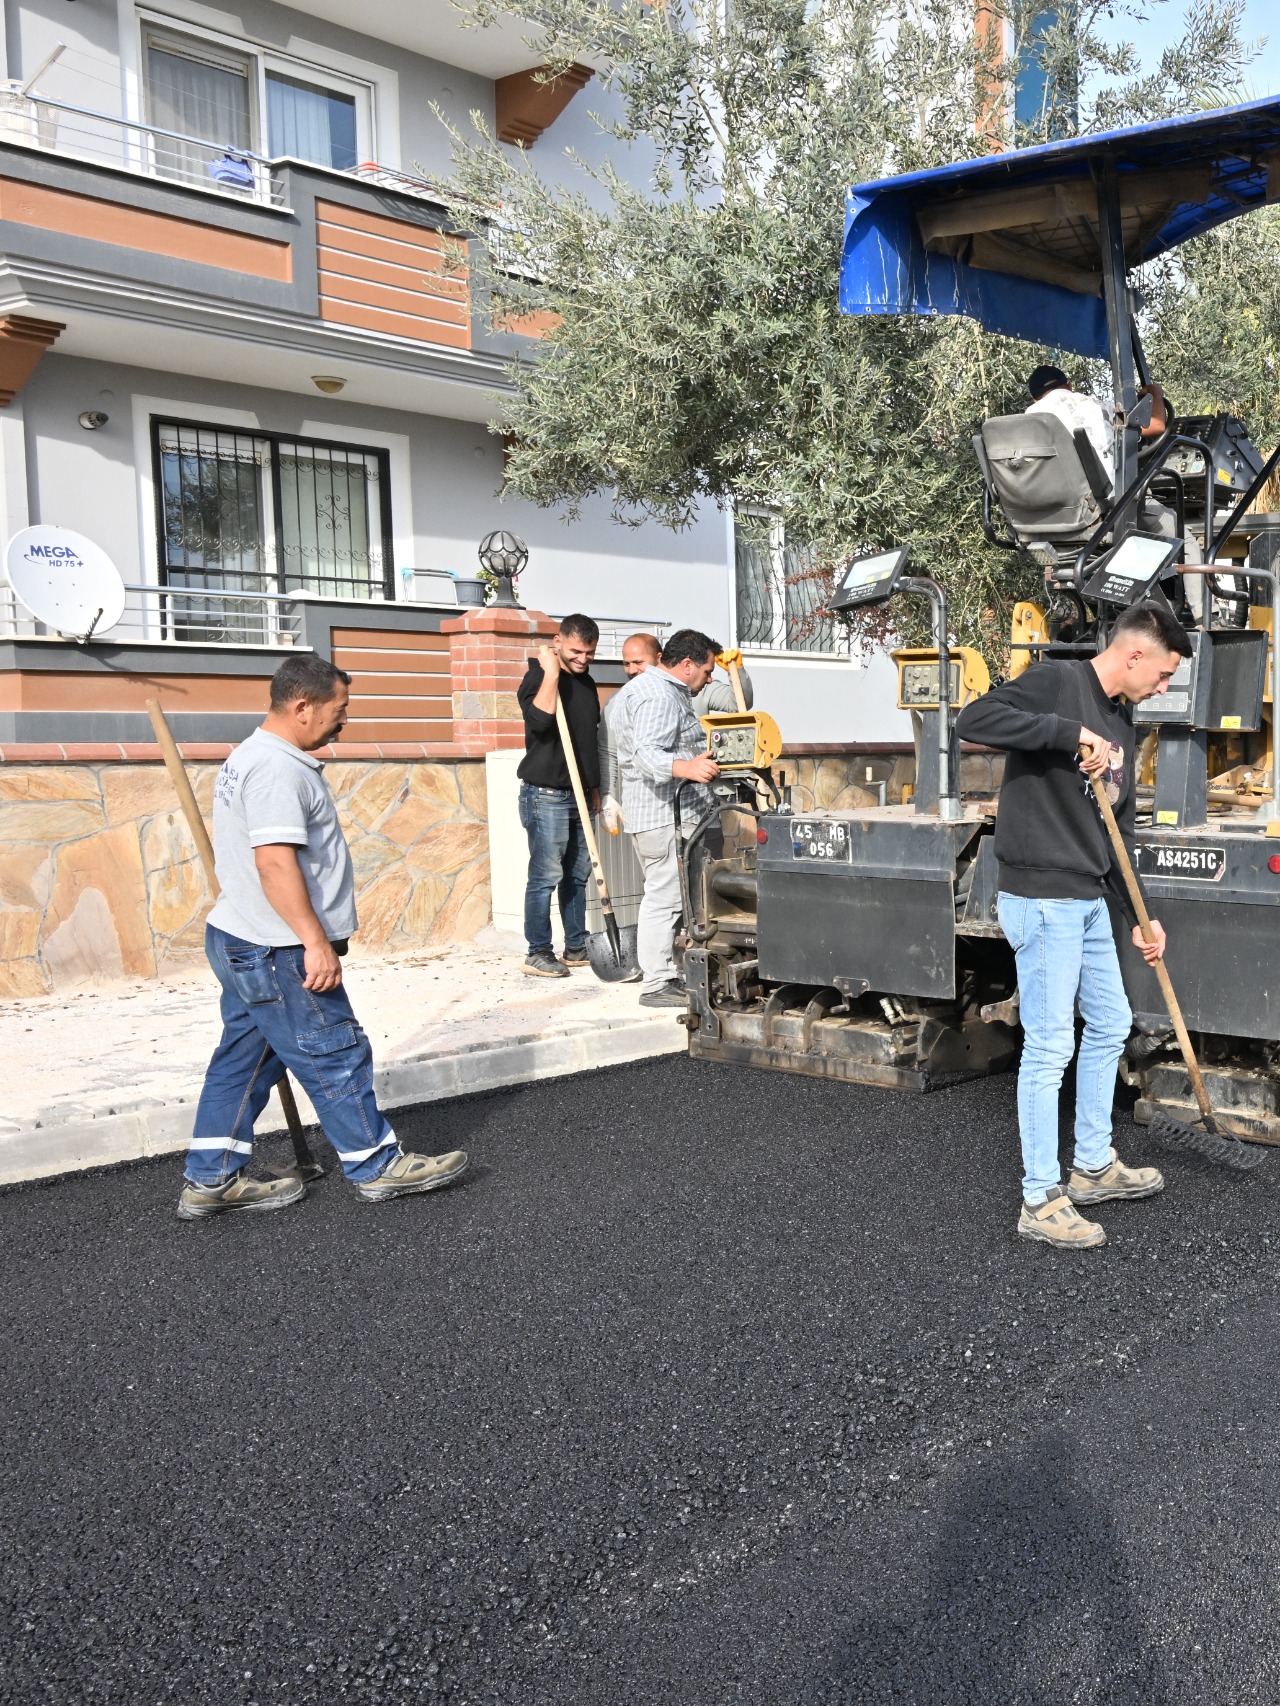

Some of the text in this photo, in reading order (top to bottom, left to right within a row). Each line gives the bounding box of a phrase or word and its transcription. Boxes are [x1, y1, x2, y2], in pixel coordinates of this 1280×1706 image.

[30, 545, 79, 558] MEGA
[1113, 584, 1130, 592] WATT
[796, 824, 812, 839] 45
[810, 842, 833, 857] 056
[1157, 850, 1217, 869] AS4251C
